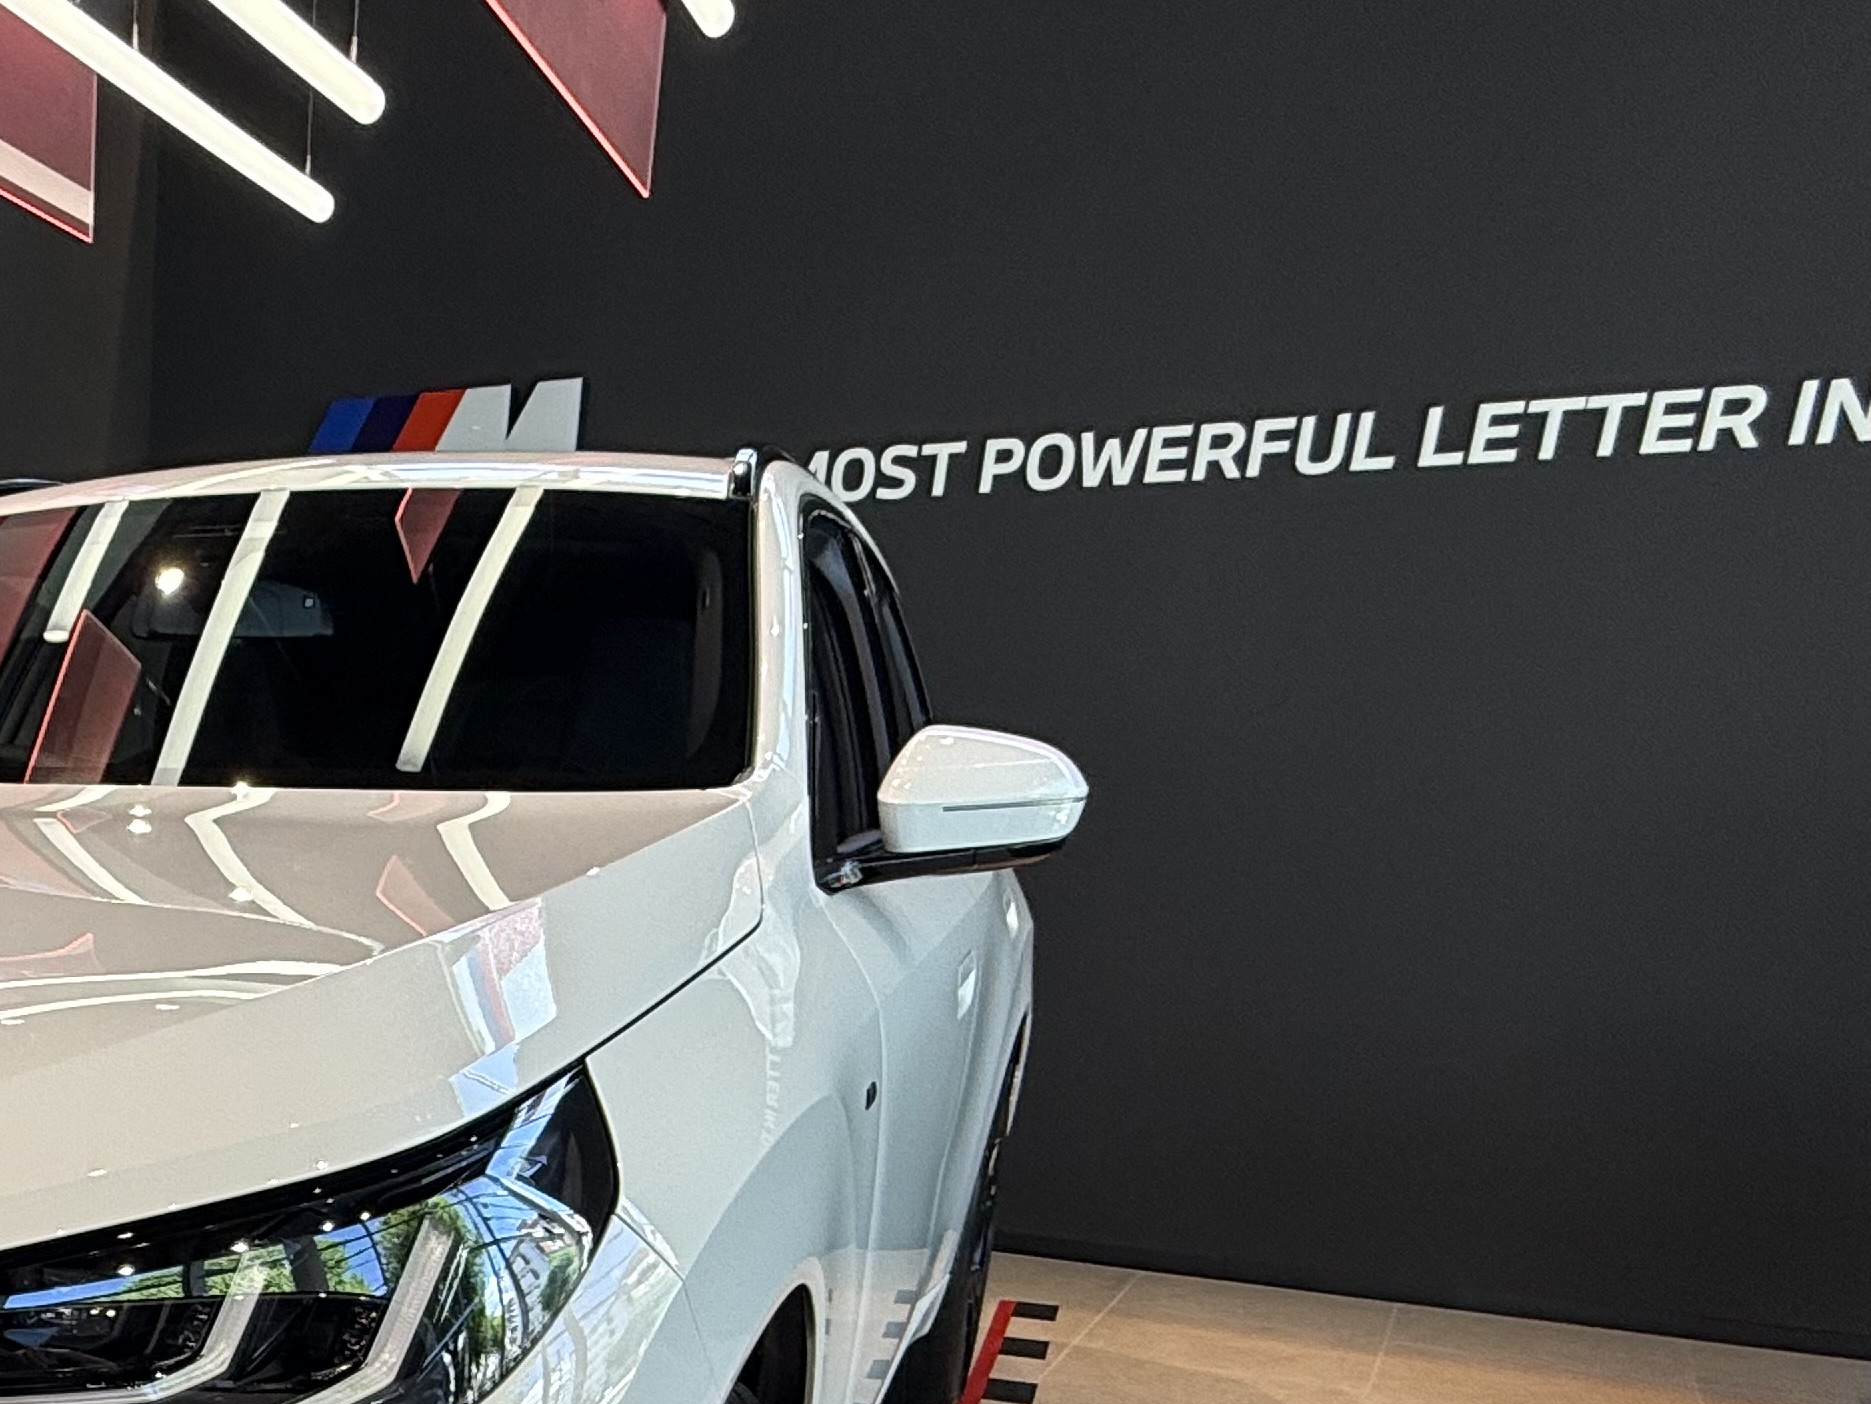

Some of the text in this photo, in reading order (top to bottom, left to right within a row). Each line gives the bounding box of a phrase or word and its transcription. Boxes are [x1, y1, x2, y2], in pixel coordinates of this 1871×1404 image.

[434, 376, 584, 452] M
[978, 410, 1396, 494] POWERFUL
[1416, 384, 1769, 469] LETTER
[1787, 377, 1871, 447] IN
